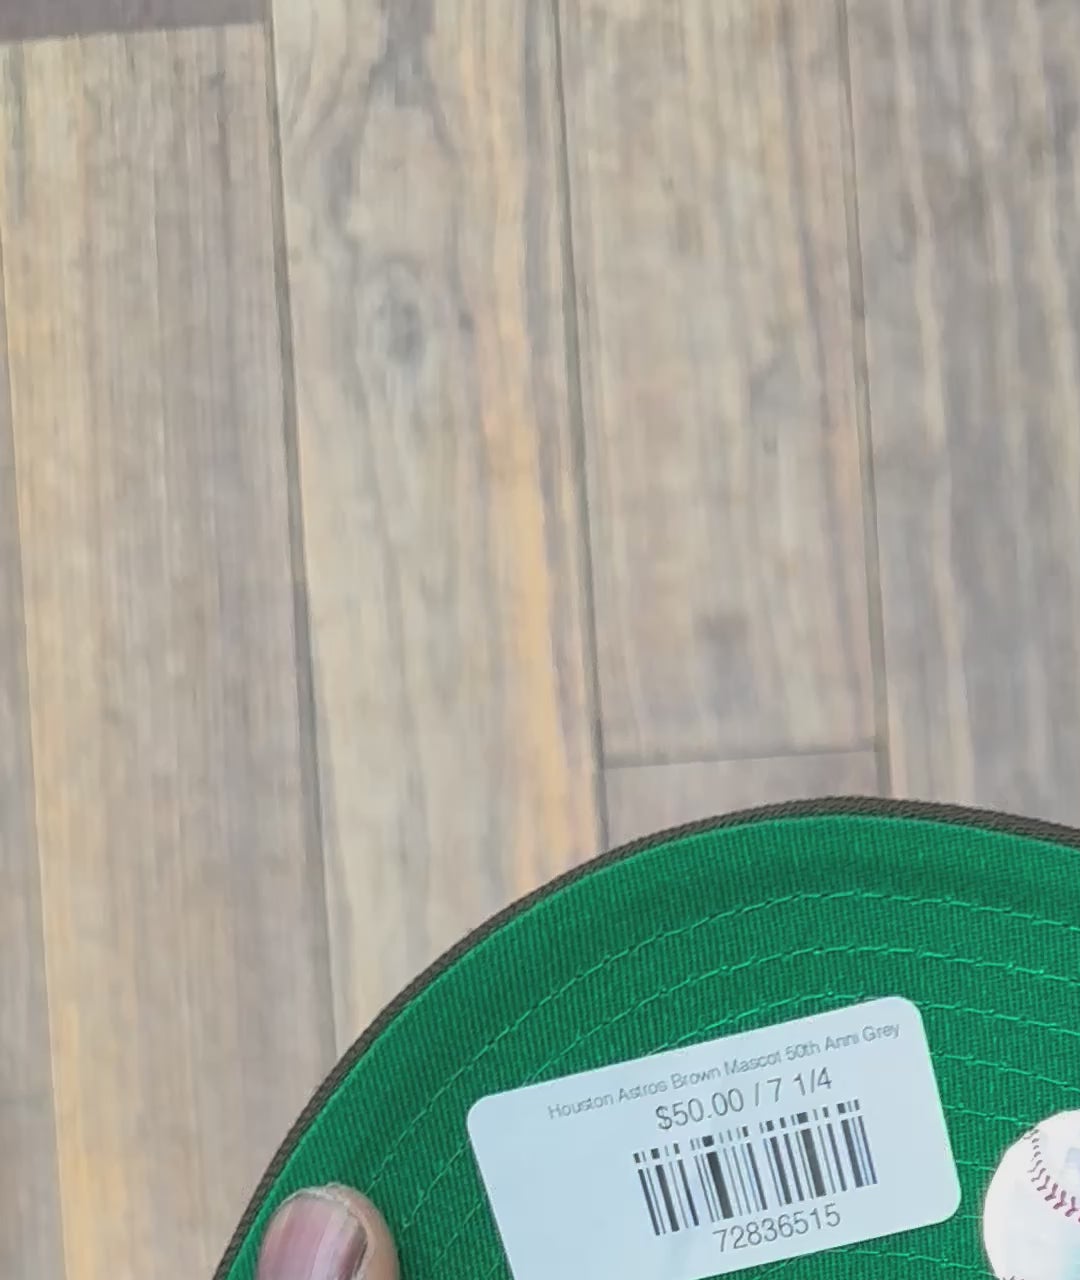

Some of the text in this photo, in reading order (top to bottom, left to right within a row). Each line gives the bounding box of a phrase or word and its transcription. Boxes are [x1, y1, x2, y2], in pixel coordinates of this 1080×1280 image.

[548, 1090, 614, 1120] Houston
[618, 1078, 668, 1104] Astros
[671, 1065, 722, 1091] Brown
[725, 1051, 783, 1077] Mascot
[787, 1040, 821, 1063] 50th
[863, 1021, 900, 1049] Grey
[655, 1065, 833, 1132] $50.00 / 7 1/4
[712, 1202, 841, 1254] 72836515
